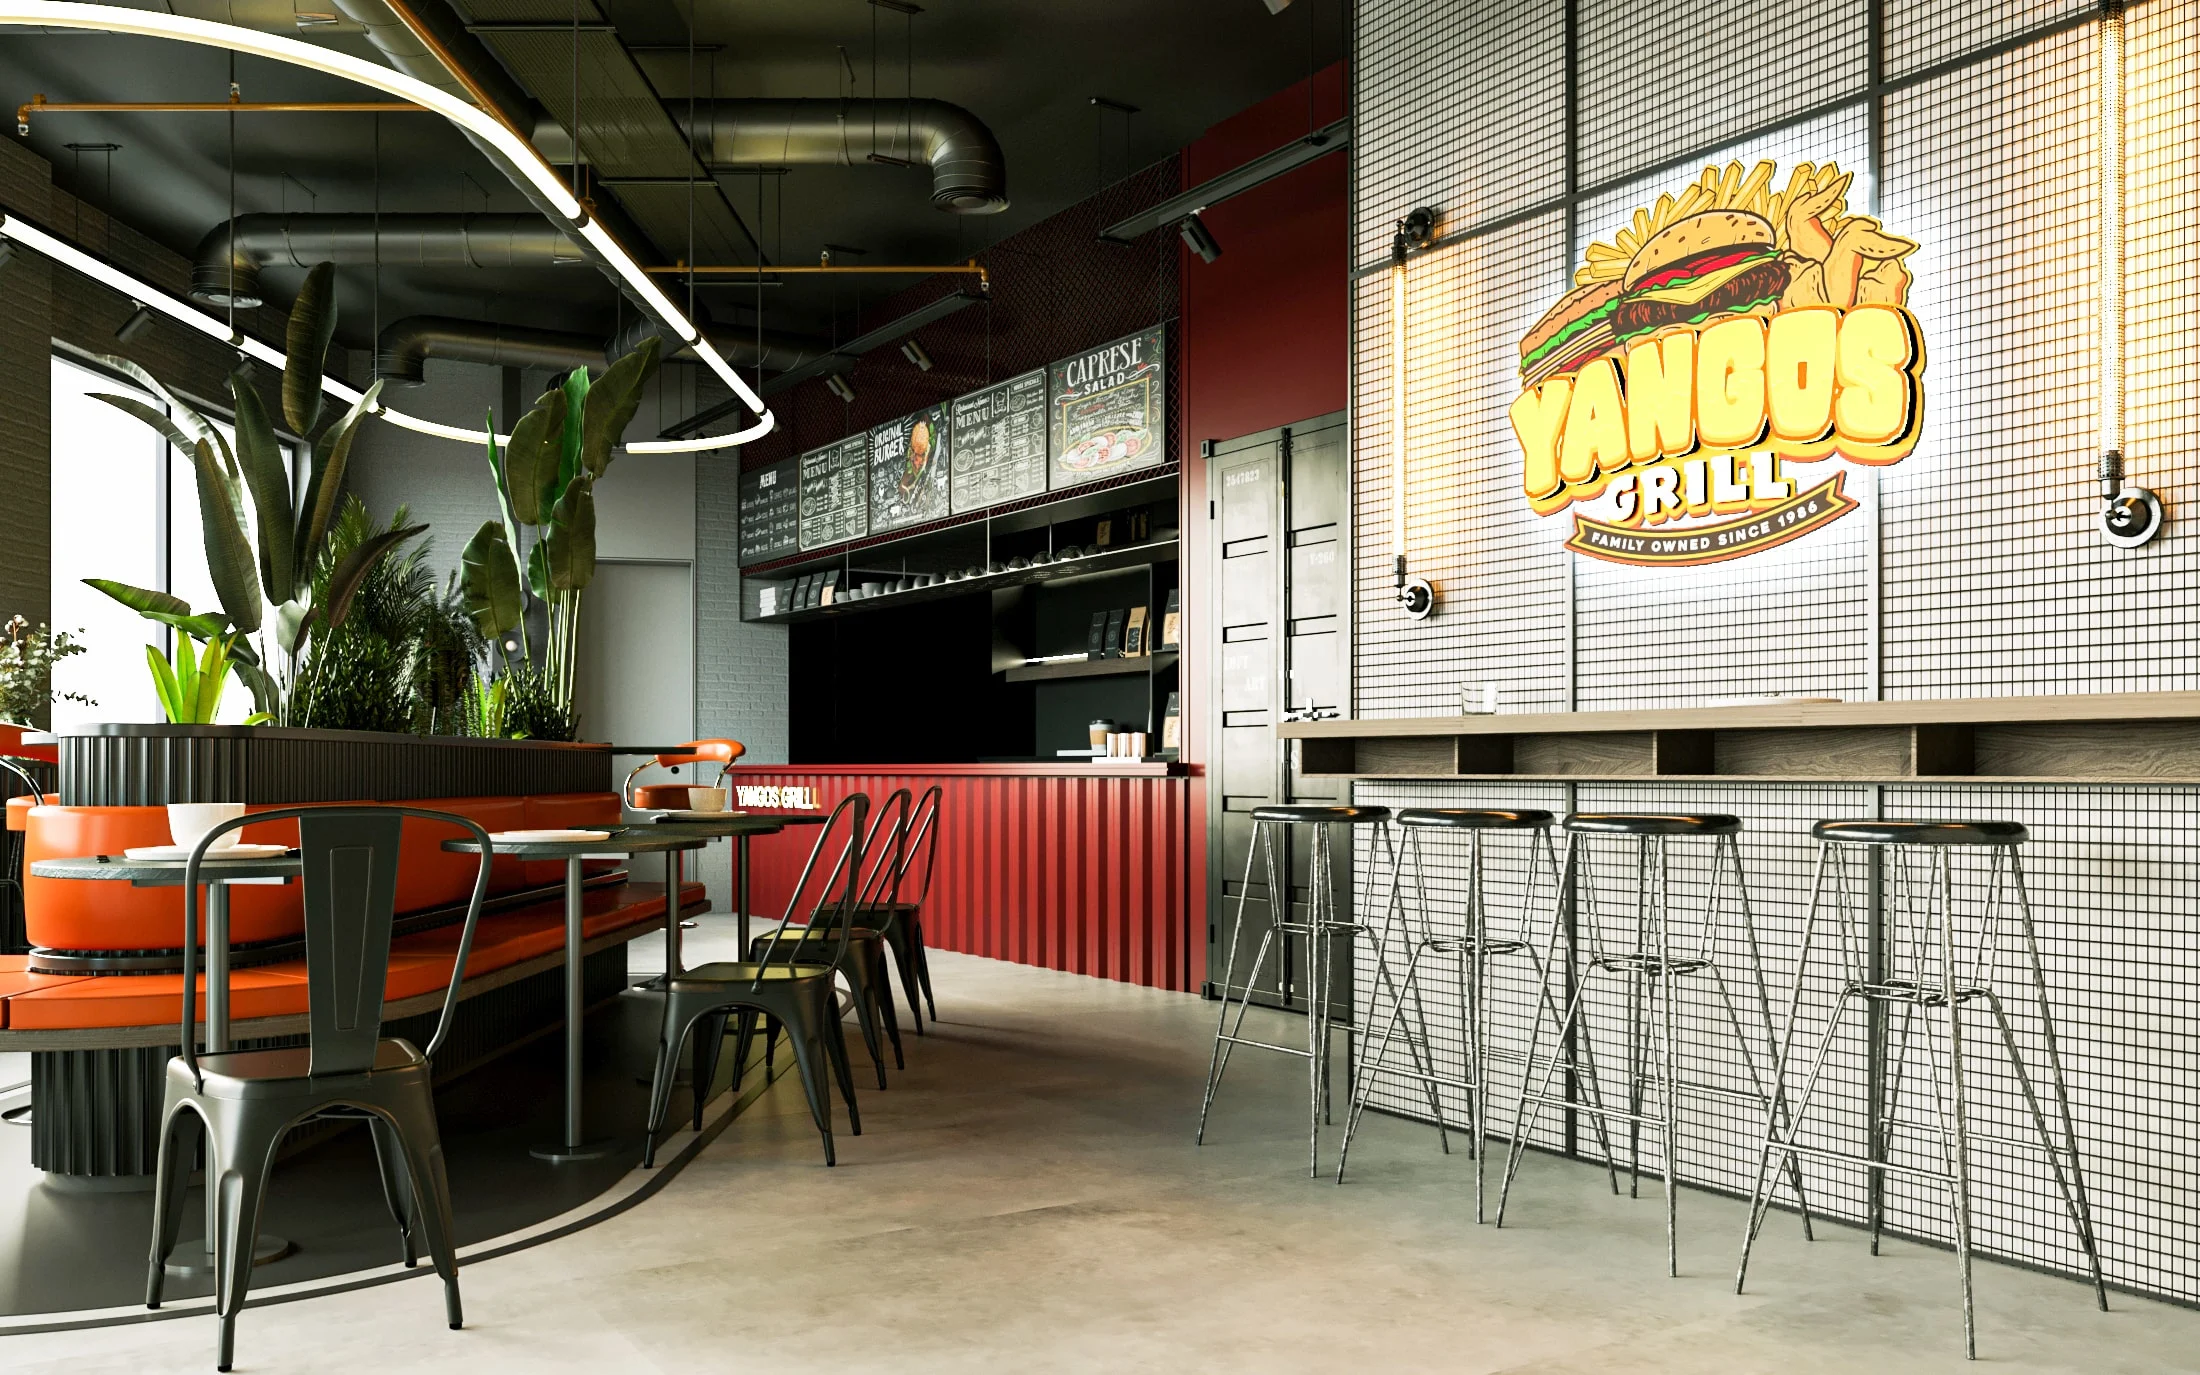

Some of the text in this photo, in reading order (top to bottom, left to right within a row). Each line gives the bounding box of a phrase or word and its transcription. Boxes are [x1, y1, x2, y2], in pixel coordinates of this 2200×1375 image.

[1066, 337, 1142, 388] CAPRESE
[1083, 372, 1125, 395] SALAD
[1509, 304, 1917, 500] YANGOS
[955, 407, 990, 429] MENU
[874, 422, 904, 449] ORIGINAL
[873, 437, 905, 467] BURGER
[759, 470, 777, 489] MENU
[802, 462, 828, 480] MENU
[1603, 451, 1791, 523] GRILL
[1591, 501, 1819, 553] FAMILY OWNED SINCE 1986
[735, 785, 815, 810] YANGOS GRILL
